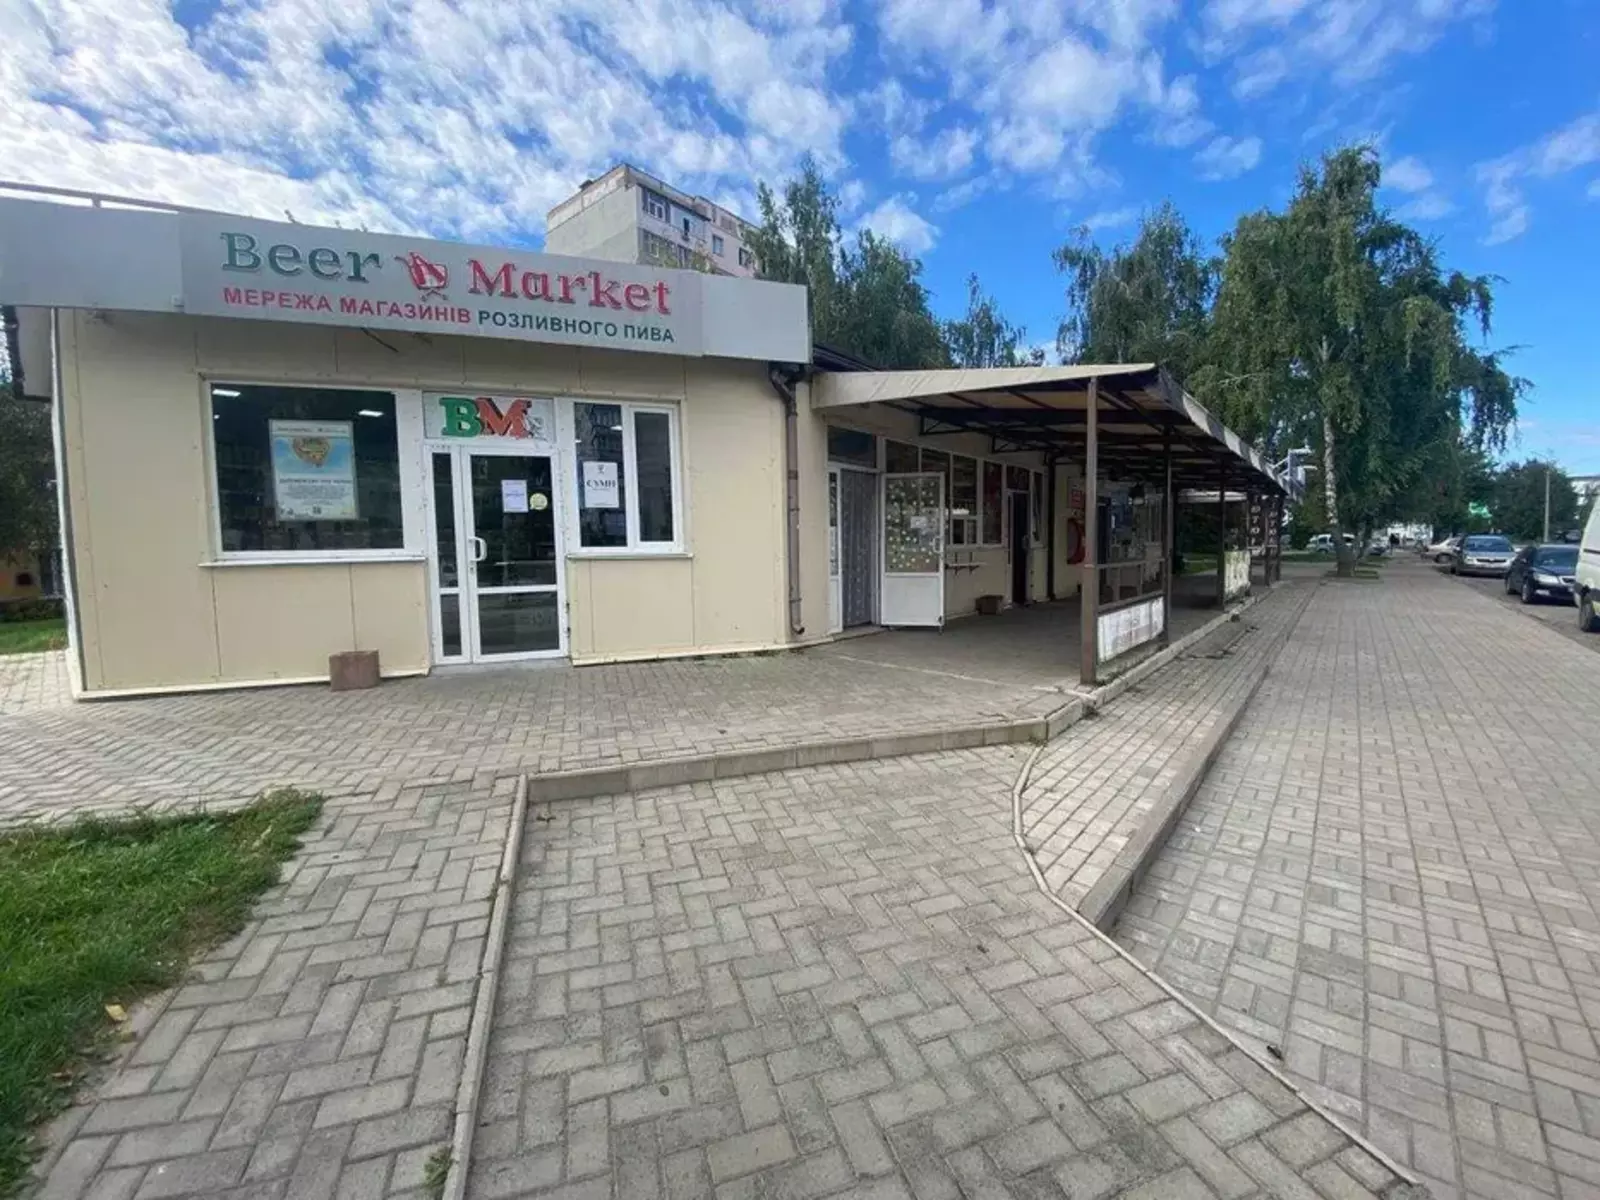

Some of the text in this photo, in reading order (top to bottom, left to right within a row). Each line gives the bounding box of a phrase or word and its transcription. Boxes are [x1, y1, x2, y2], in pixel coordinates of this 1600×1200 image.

[220, 232, 672, 315] Beer Market
[223, 287, 675, 343] МЕРЕЖА МАГАЗИНІВ РОЗЛИВНОГО ПИВА
[438, 396, 533, 439] BM
